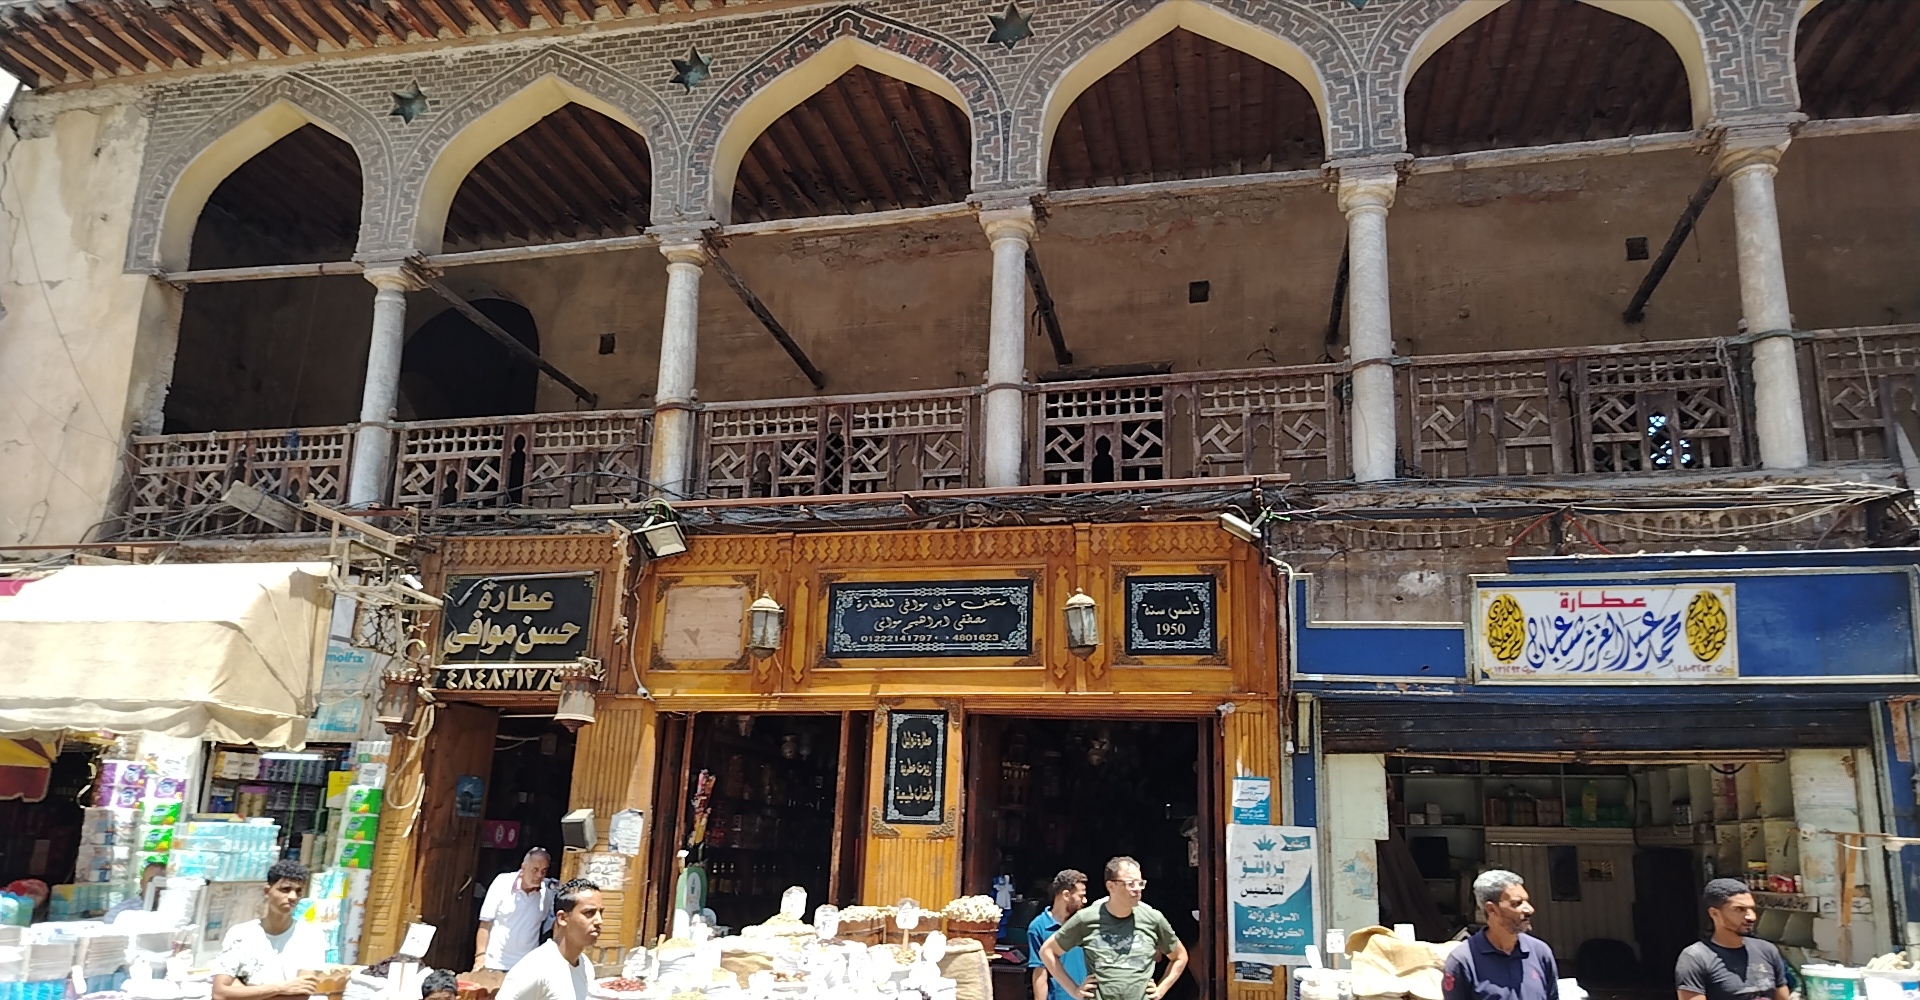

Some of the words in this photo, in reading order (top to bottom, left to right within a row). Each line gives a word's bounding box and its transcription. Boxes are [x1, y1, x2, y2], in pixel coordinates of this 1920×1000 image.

[478, 582, 555, 613] عطارة
[932, 598, 957, 611] خان
[960, 598, 1007, 610] متحف
[1560, 590, 1647, 613] عطارة
[856, 598, 896, 612] للعطارة
[1141, 603, 1166, 616] سنة
[1167, 596, 1200, 620] تأسس
[953, 613, 988, 630] مصطفى
[515, 615, 581, 654] حسن
[1156, 623, 1186, 636] 1950
[952, 634, 1000, 642] 4801623
[1526, 615, 1585, 669] شعبان
[1274, 927, 1305, 939] الكرش
